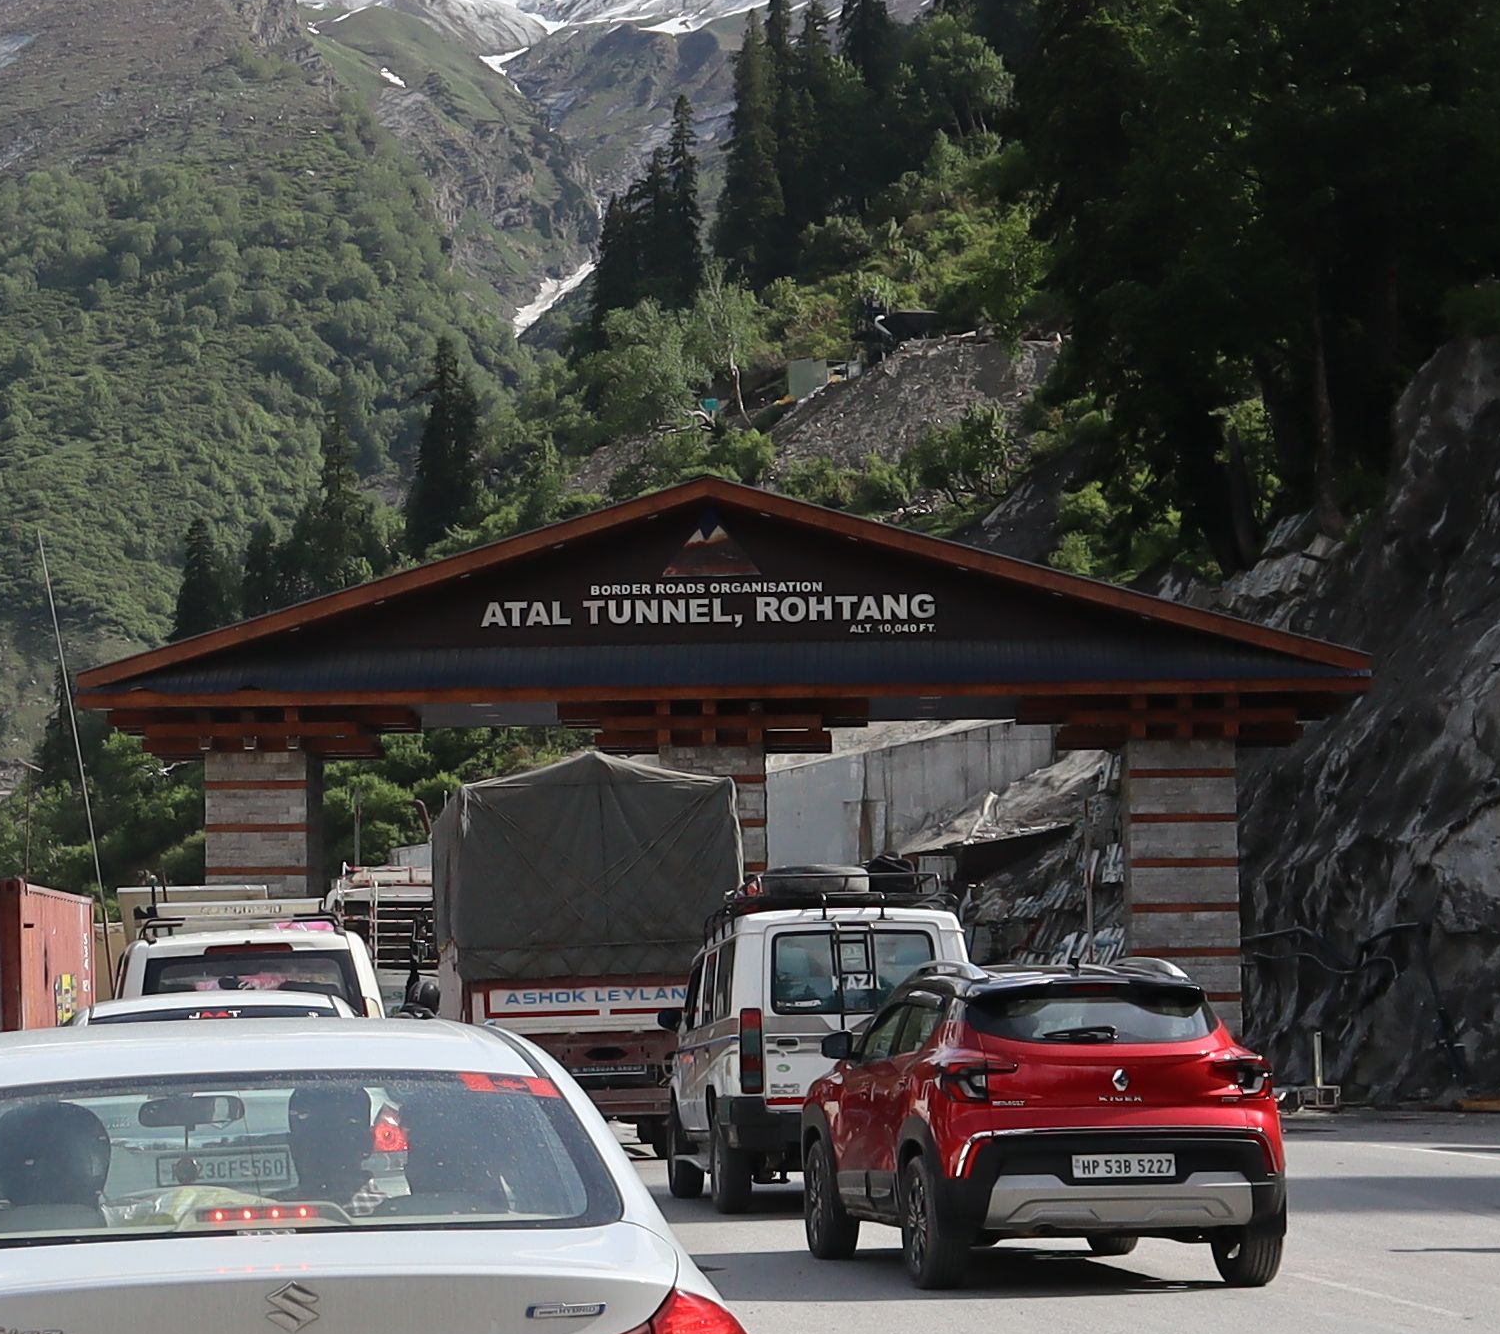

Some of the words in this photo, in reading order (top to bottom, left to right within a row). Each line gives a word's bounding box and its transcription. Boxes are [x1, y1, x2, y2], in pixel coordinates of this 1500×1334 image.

[590, 584, 652, 596] BORDER
[655, 583, 706, 595] ROADS
[709, 581, 823, 594] ORGANISATION
[480, 600, 572, 628] ATAL
[582, 597, 743, 628] TUNNEL,
[756, 593, 936, 623] ROHTANG
[849, 624, 874, 634] ALT.
[877, 623, 917, 634] 10,040
[919, 623, 937, 633] FT.
[505, 990, 587, 1005] ASHOK
[595, 986, 687, 1003] LEYLAN
[172, 1158, 284, 1181] 23CF5560
[1082, 1160, 1100, 1174] HP
[1104, 1159, 1132, 1174] 53B
[1137, 1158, 1173, 1174] 5227
